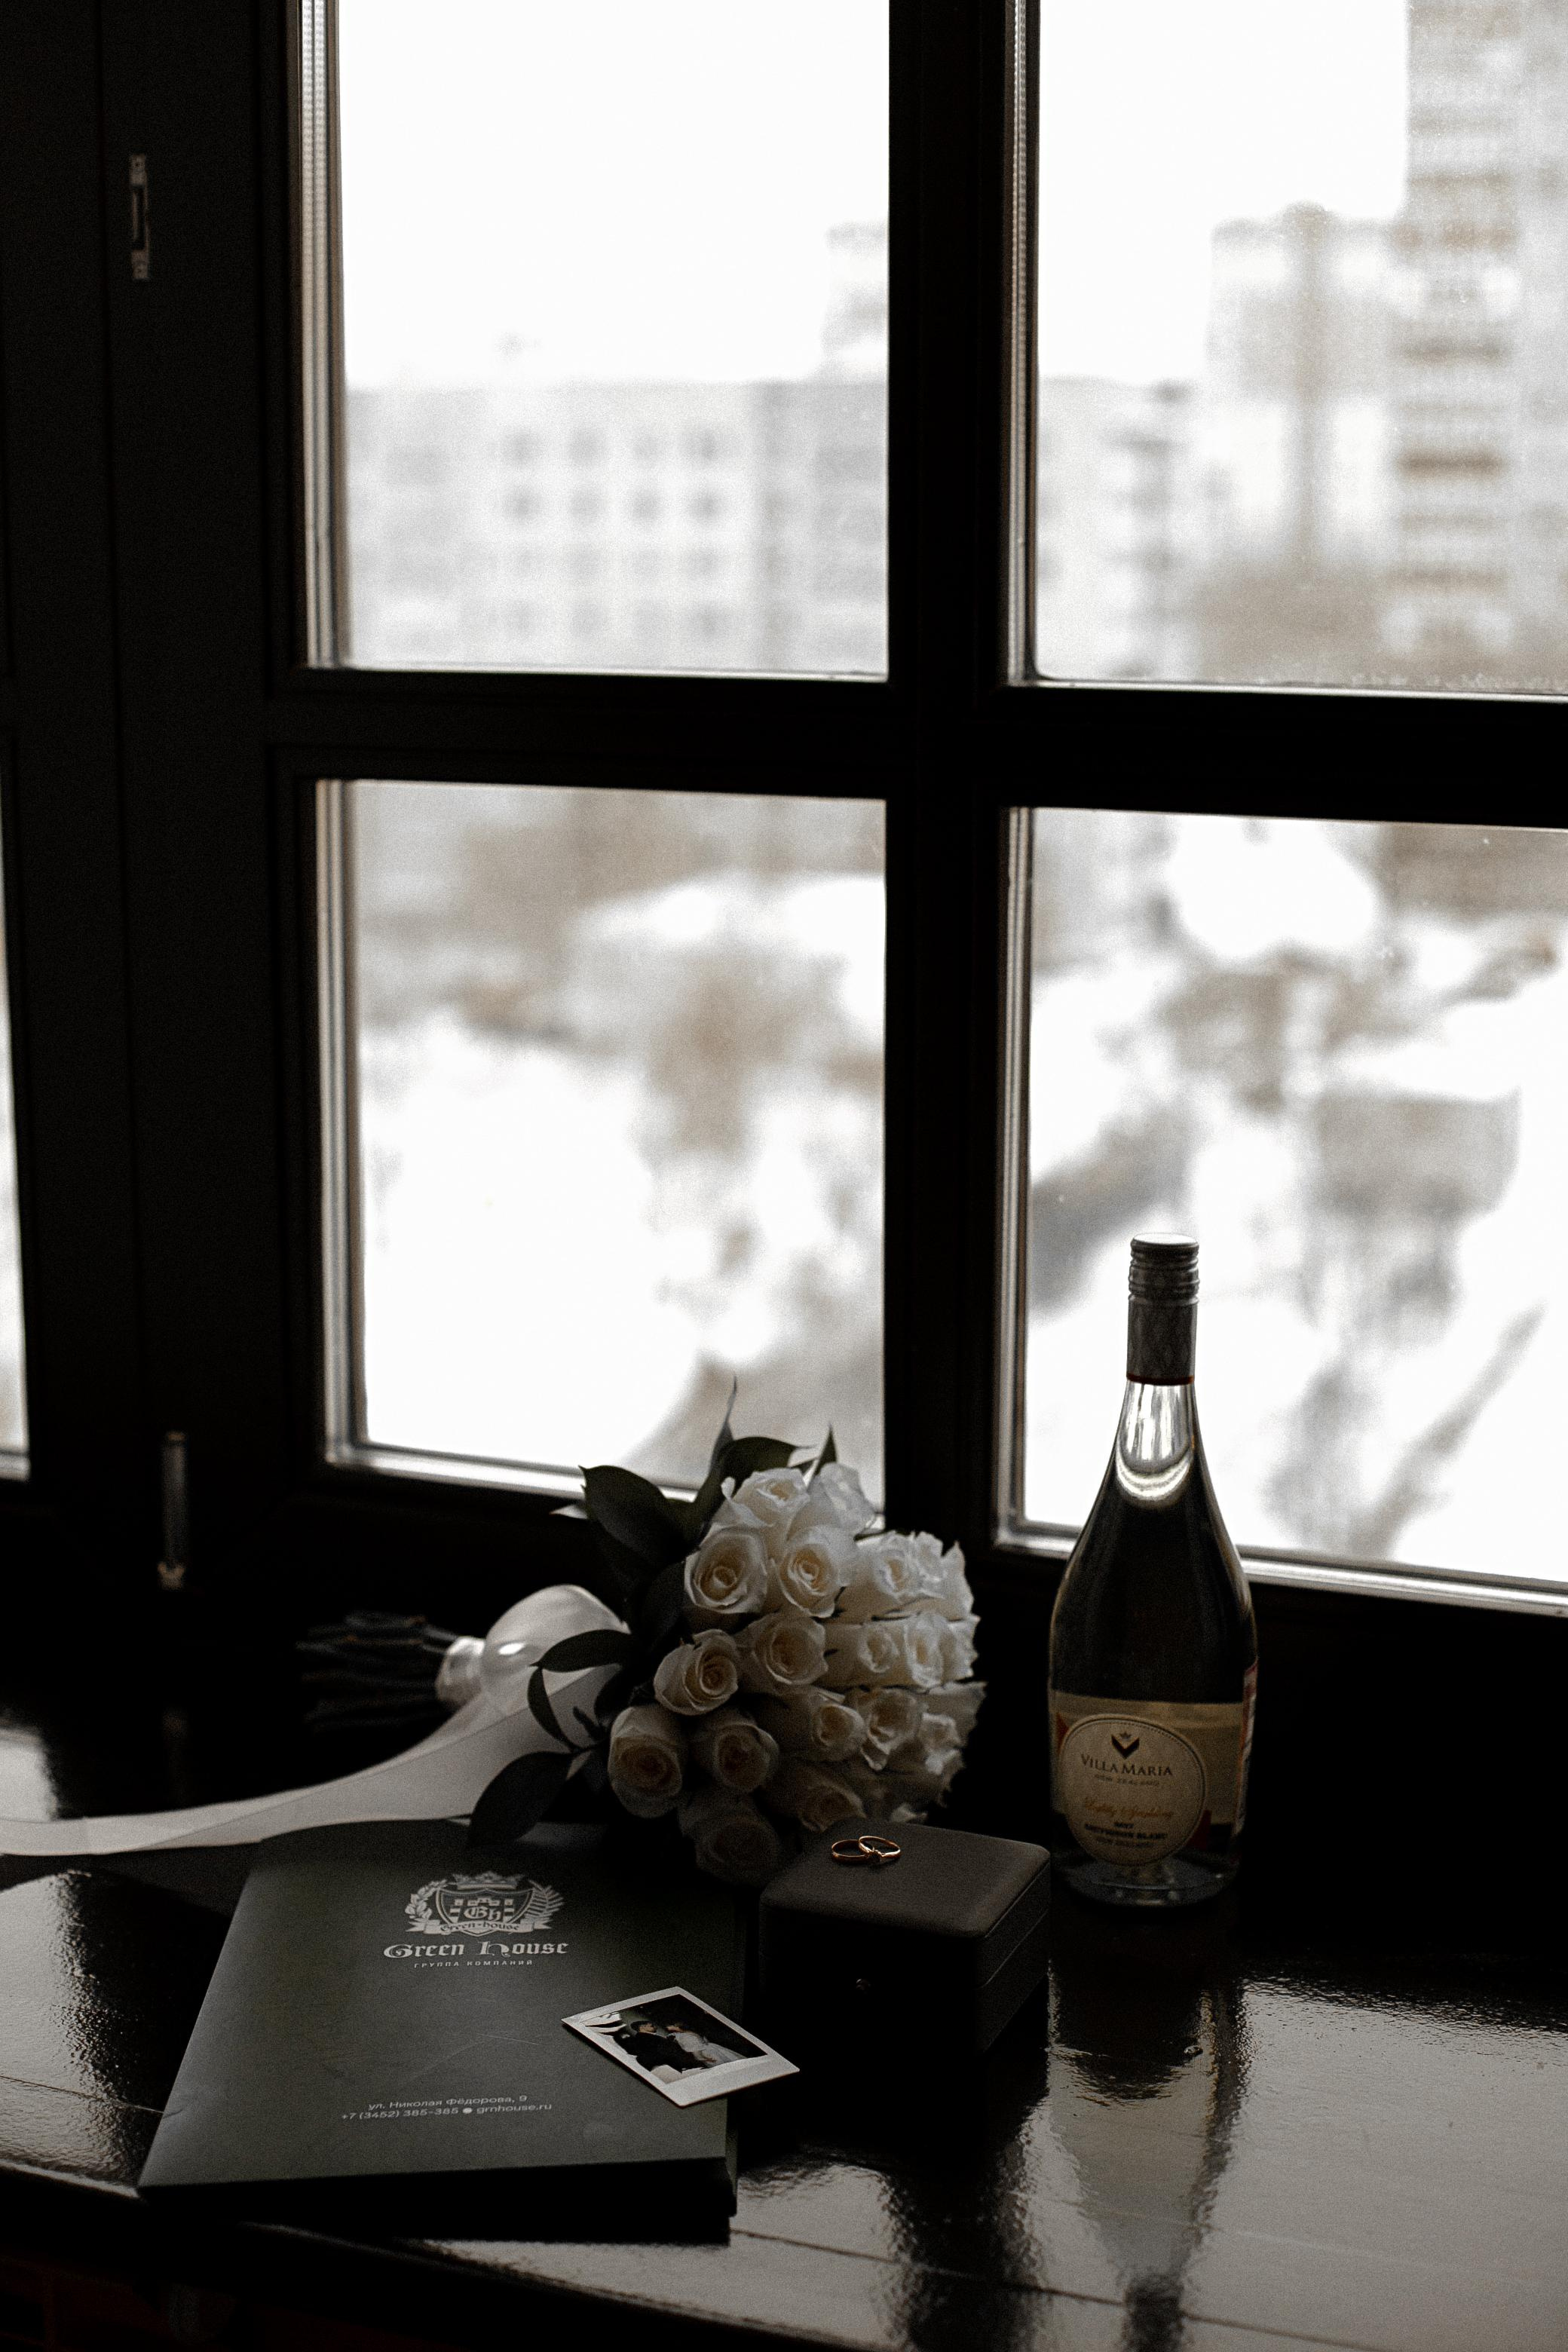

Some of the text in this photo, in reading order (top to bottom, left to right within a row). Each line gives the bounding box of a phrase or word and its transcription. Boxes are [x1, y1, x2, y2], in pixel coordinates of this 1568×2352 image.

[1081, 1753, 1173, 1776] VILLA MARIA
[383, 1943, 464, 1958] Green
[389, 2100, 443, 2109] Николая
[446, 2096, 515, 2105] Фёдорова,
[359, 2110, 400, 2120] (3452)
[476, 2104, 552, 2115] grnhouse.ru
